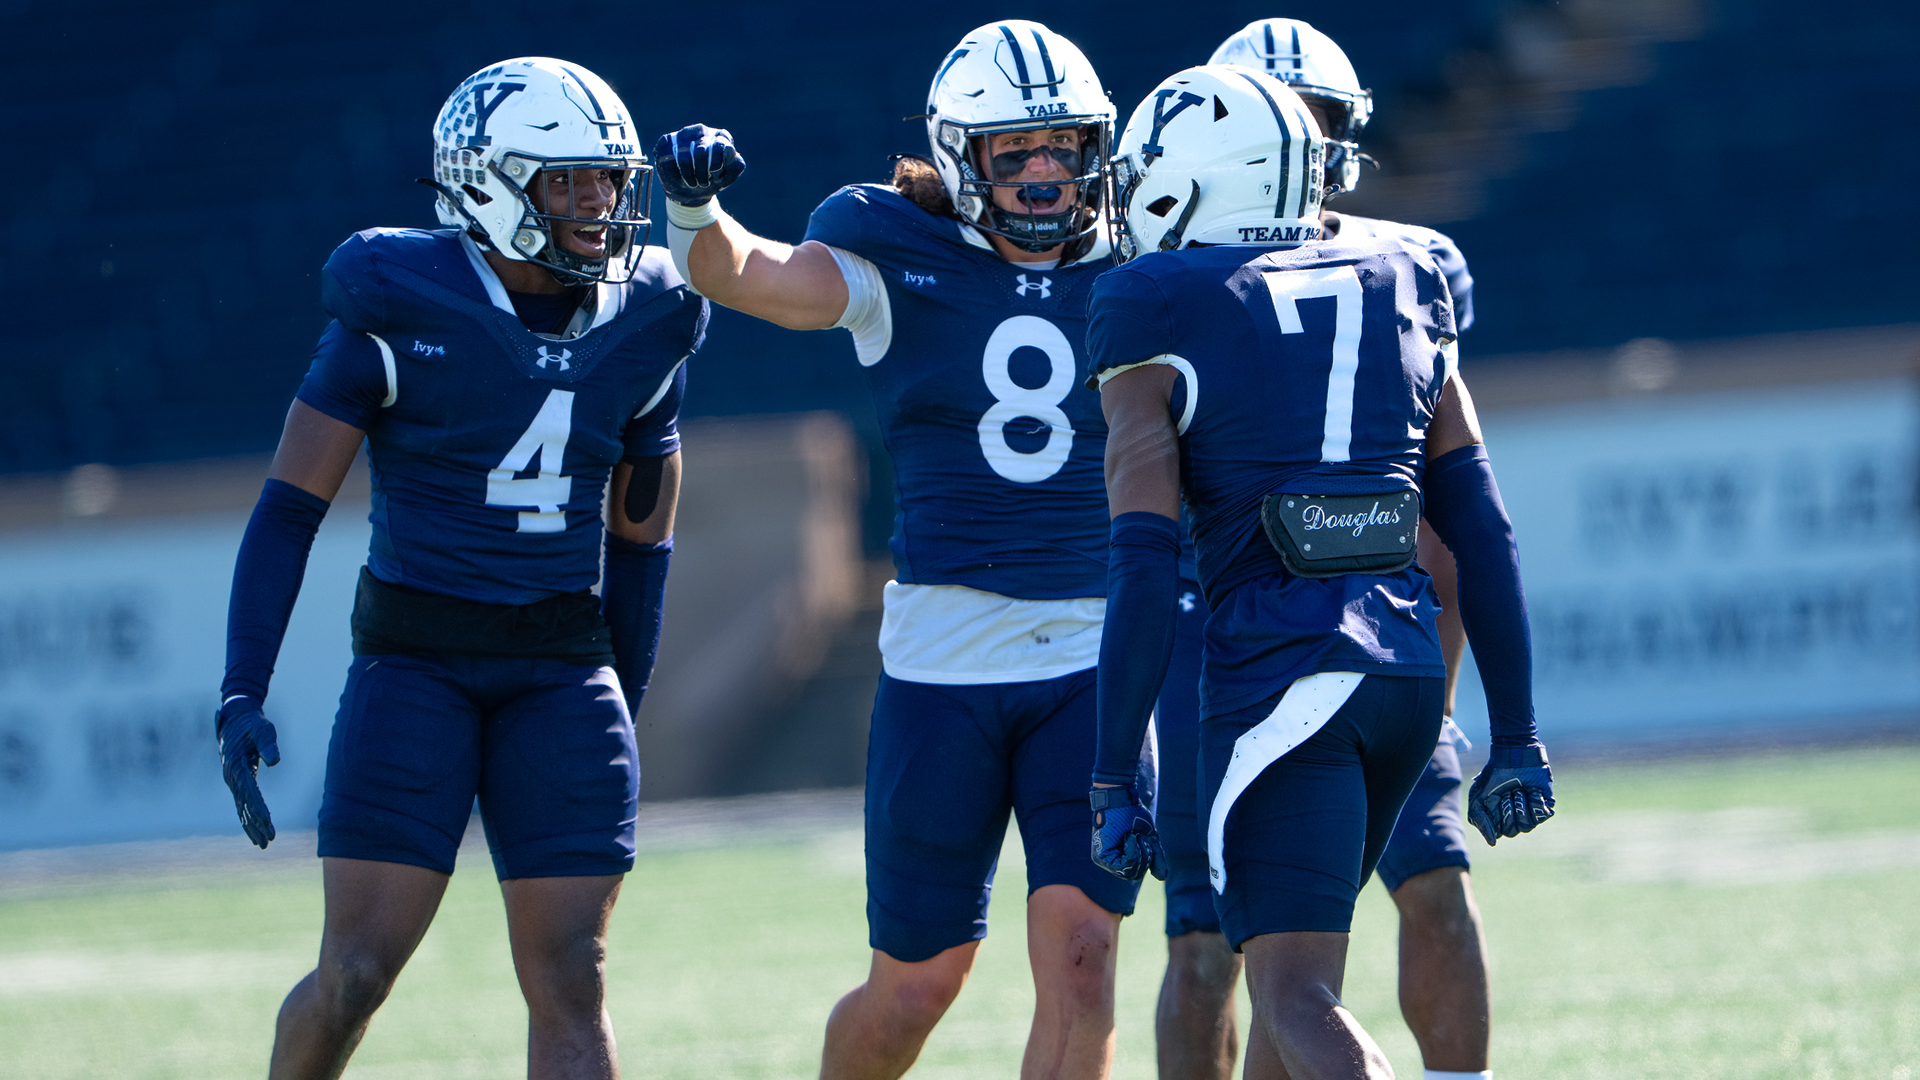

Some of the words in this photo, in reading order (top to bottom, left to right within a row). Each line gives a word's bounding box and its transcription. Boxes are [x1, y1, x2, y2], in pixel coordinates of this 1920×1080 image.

[468, 82, 527, 147] Y
[1025, 102, 1068, 117] YALE
[1142, 89, 1206, 158] Y
[603, 144, 635, 155] YALE
[1264, 184, 1272, 195] 7
[1238, 226, 1302, 242] TEAM
[904, 271, 925, 286] Ivy
[413, 340, 434, 356] Ivy
[1261, 265, 1363, 463] 7
[976, 315, 1076, 483] 8
[485, 388, 575, 533] 4
[1302, 501, 1400, 537] Douglas
